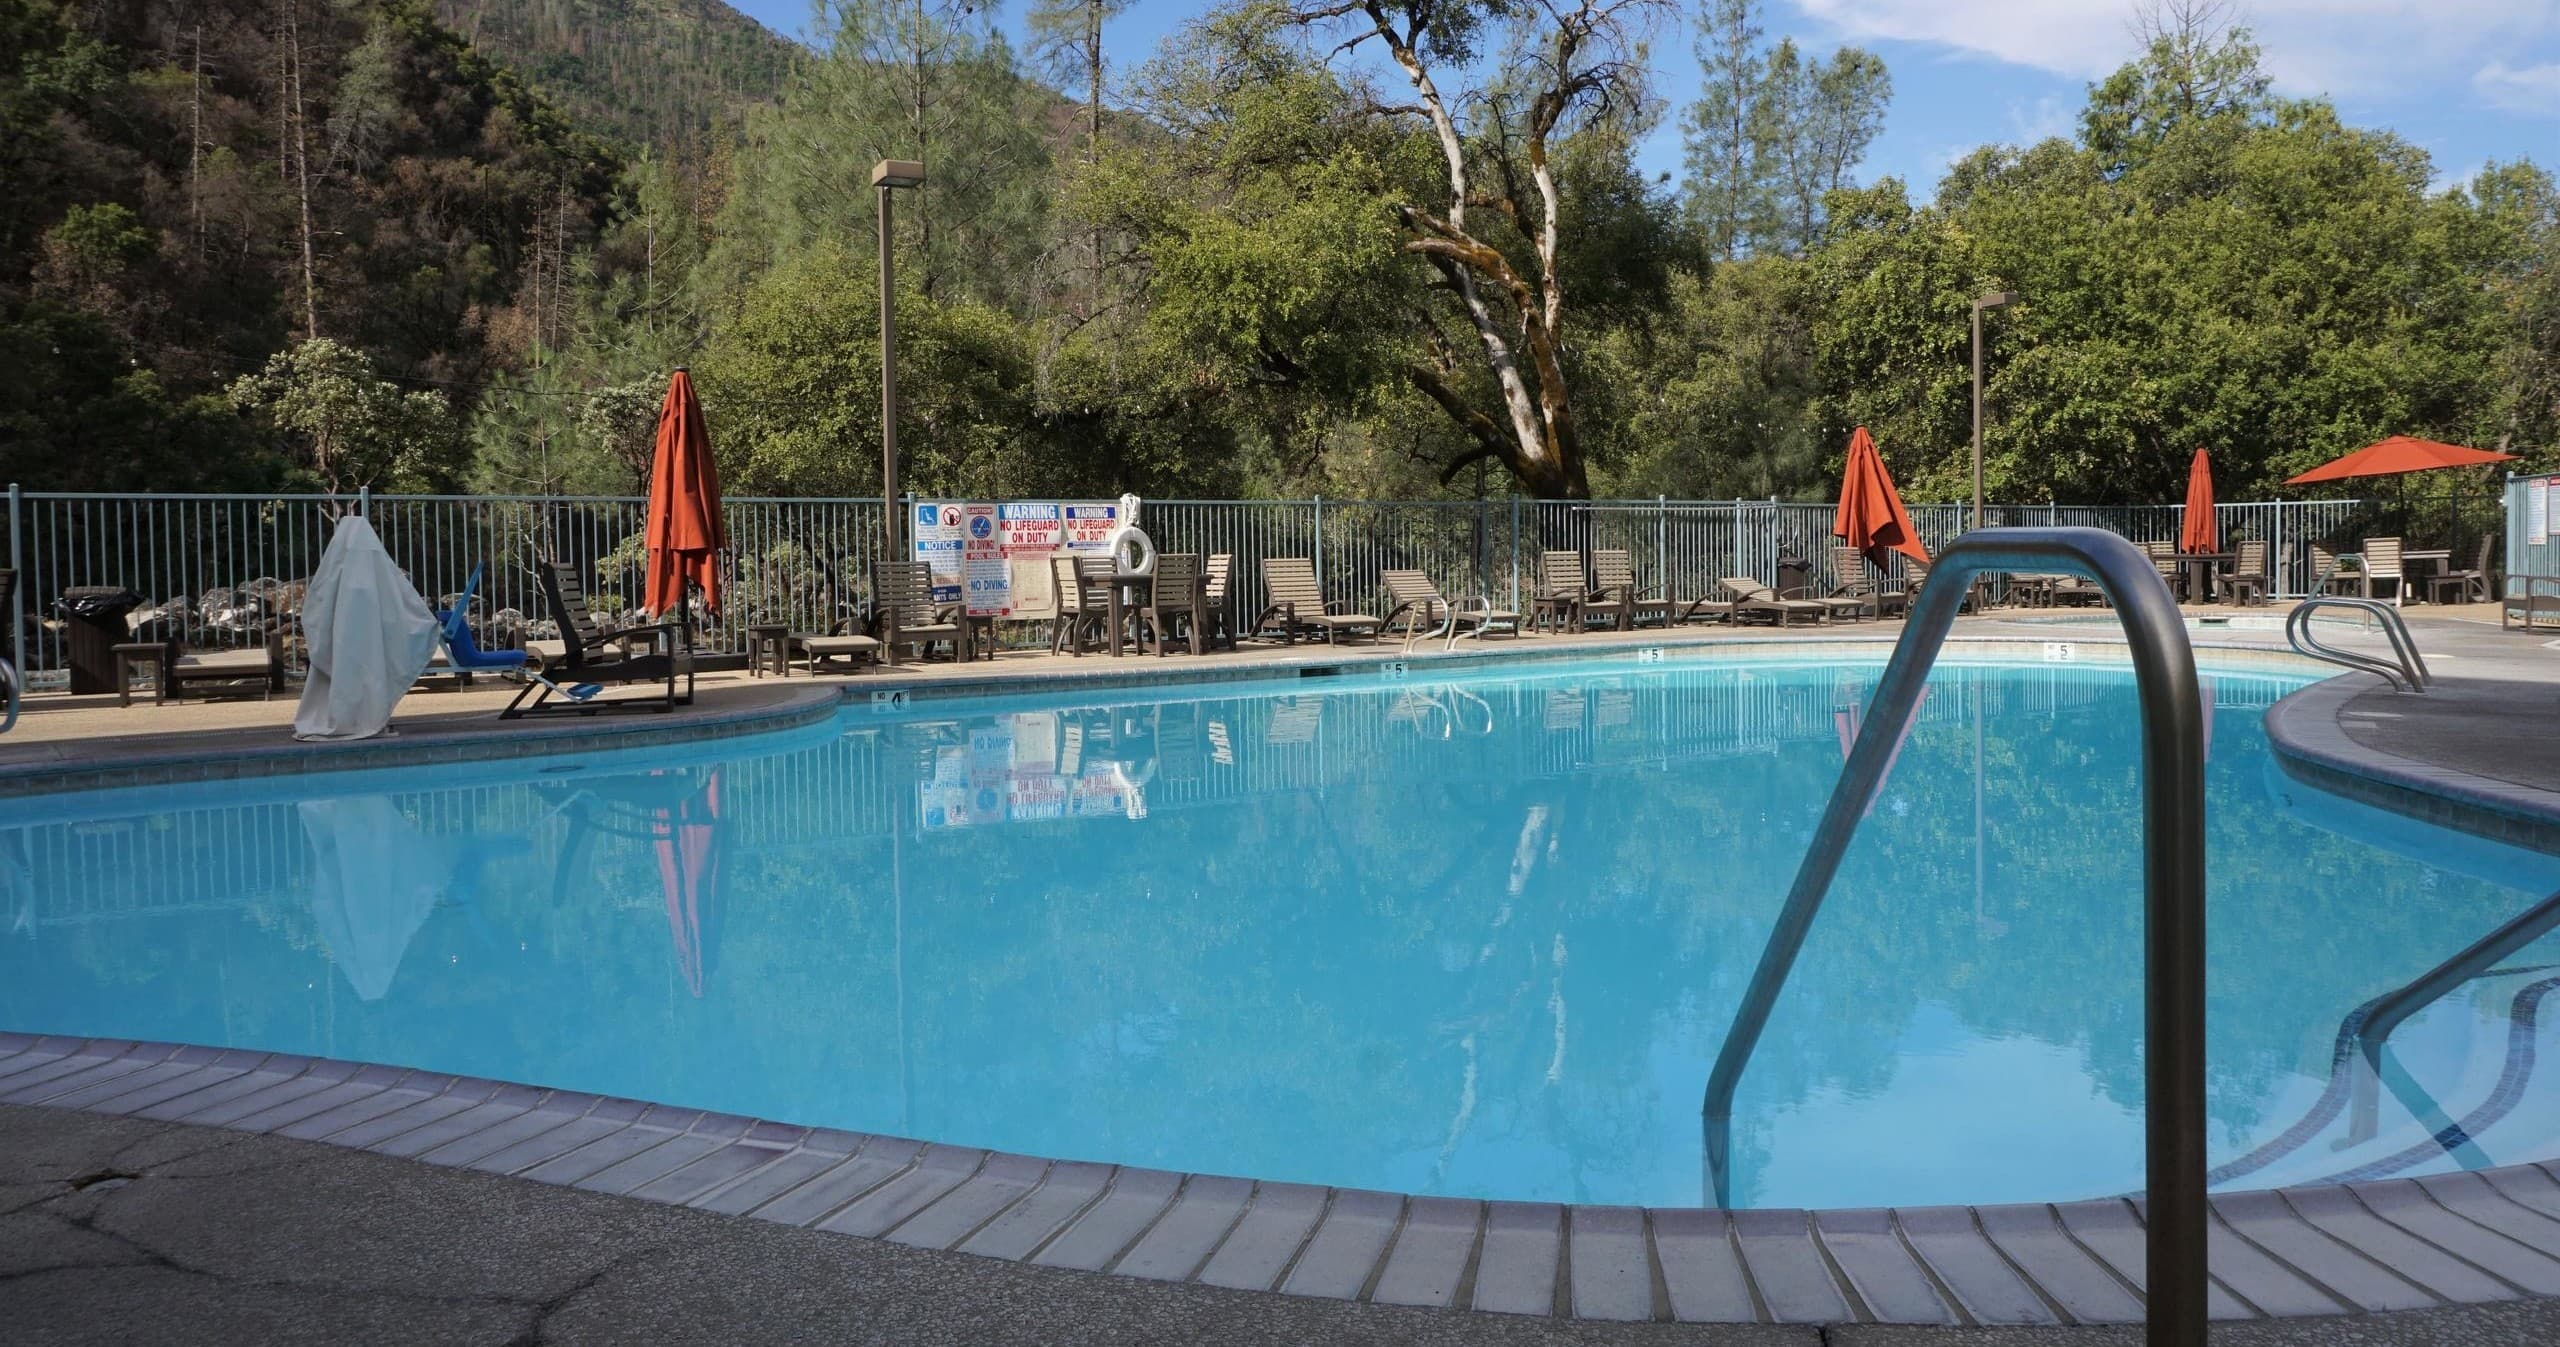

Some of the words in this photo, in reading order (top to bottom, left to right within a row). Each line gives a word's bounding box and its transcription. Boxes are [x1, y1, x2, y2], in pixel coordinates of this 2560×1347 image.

[1003, 505, 1056, 519] WARNING
[1075, 507, 1108, 519] WARNING
[1000, 520, 1012, 531] NO
[1015, 520, 1059, 531] LIFEGUARD
[1068, 520, 1077, 529] NO
[1080, 520, 1114, 529] LIFEGUARD
[1012, 532, 1023, 543] ON
[1027, 532, 1048, 543] DUTY
[1077, 531, 1086, 540] ON
[1089, 531, 1107, 540] DUTY
[925, 541, 957, 550] NOTICE
[967, 541, 975, 550] NO
[971, 580, 981, 590] NO
[948, 592, 962, 600] ONLY
